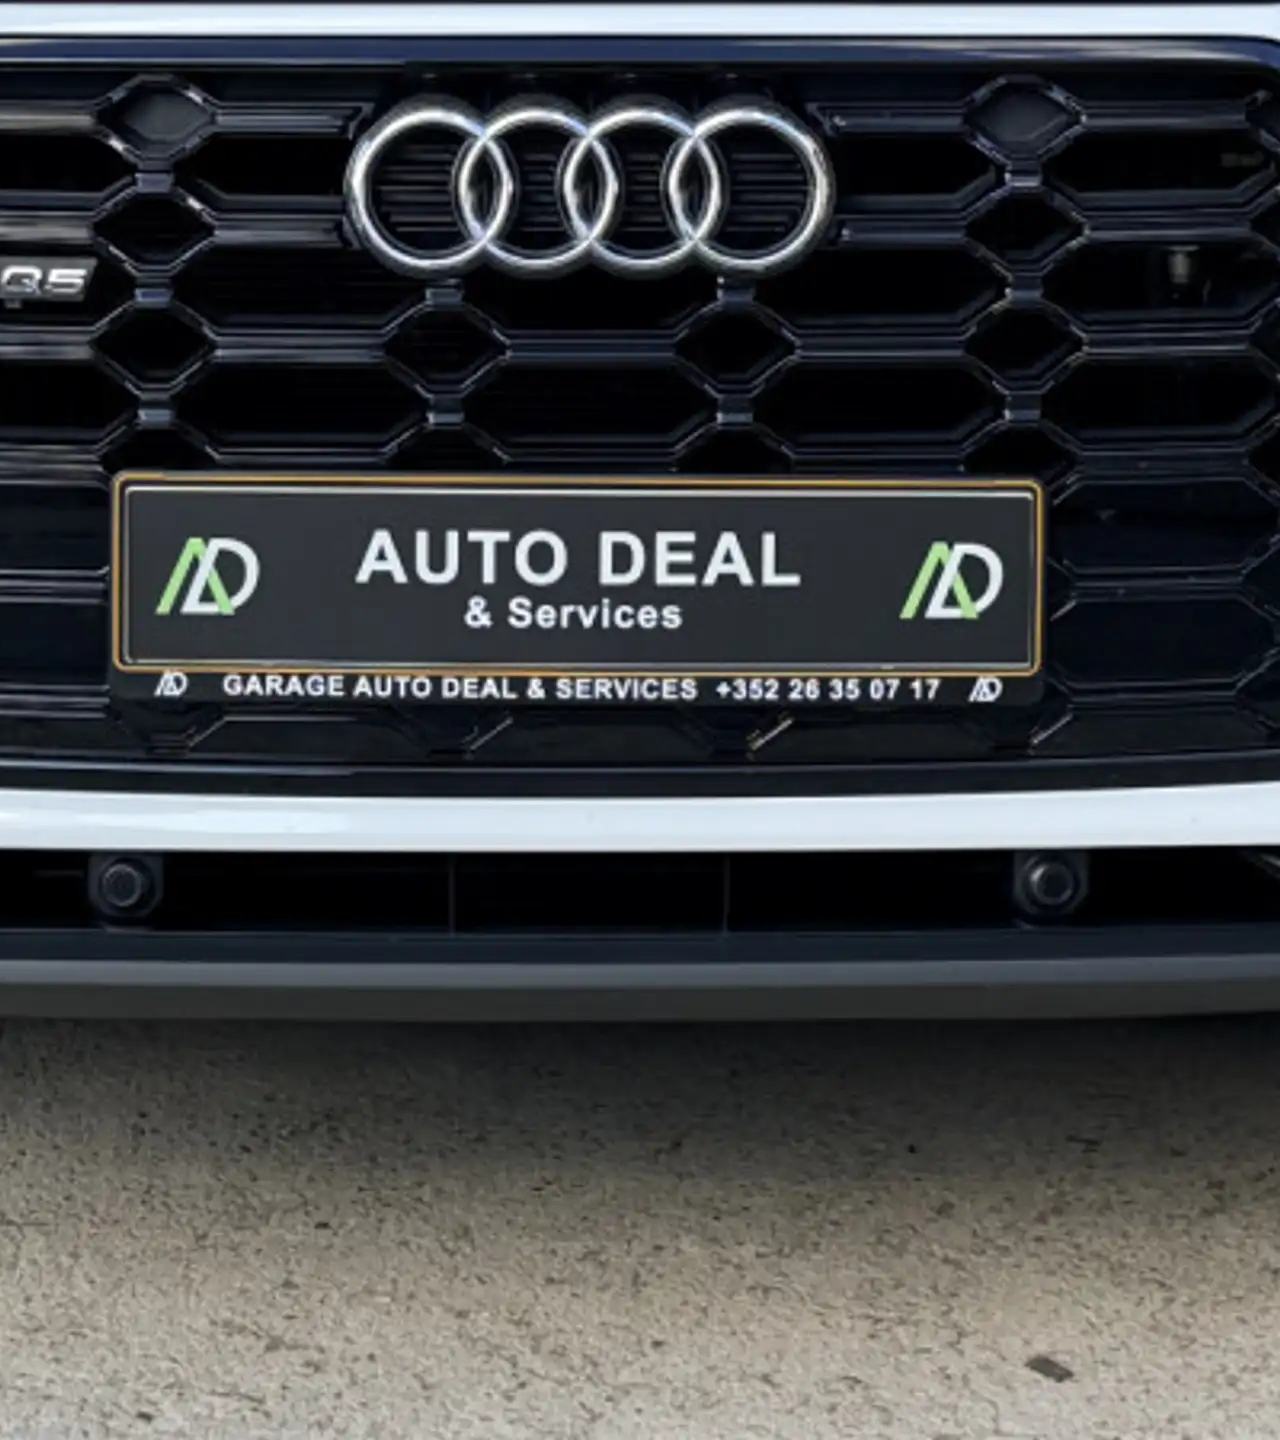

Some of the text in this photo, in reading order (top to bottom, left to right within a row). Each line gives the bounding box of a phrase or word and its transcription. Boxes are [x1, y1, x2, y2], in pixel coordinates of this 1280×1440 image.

[354, 528, 569, 586] AUTO
[598, 530, 802, 587] DEAL
[463, 595, 684, 629] & Services
[222, 674, 345, 697] GARAGE
[352, 674, 433, 699] AUTO
[441, 676, 518, 700] DEAL
[526, 676, 546, 700] &
[555, 677, 699, 701] SERVICES
[715, 678, 780, 701] +352
[828, 678, 861, 701] 35
[869, 678, 901, 701] 07
[908, 678, 942, 701] 17
